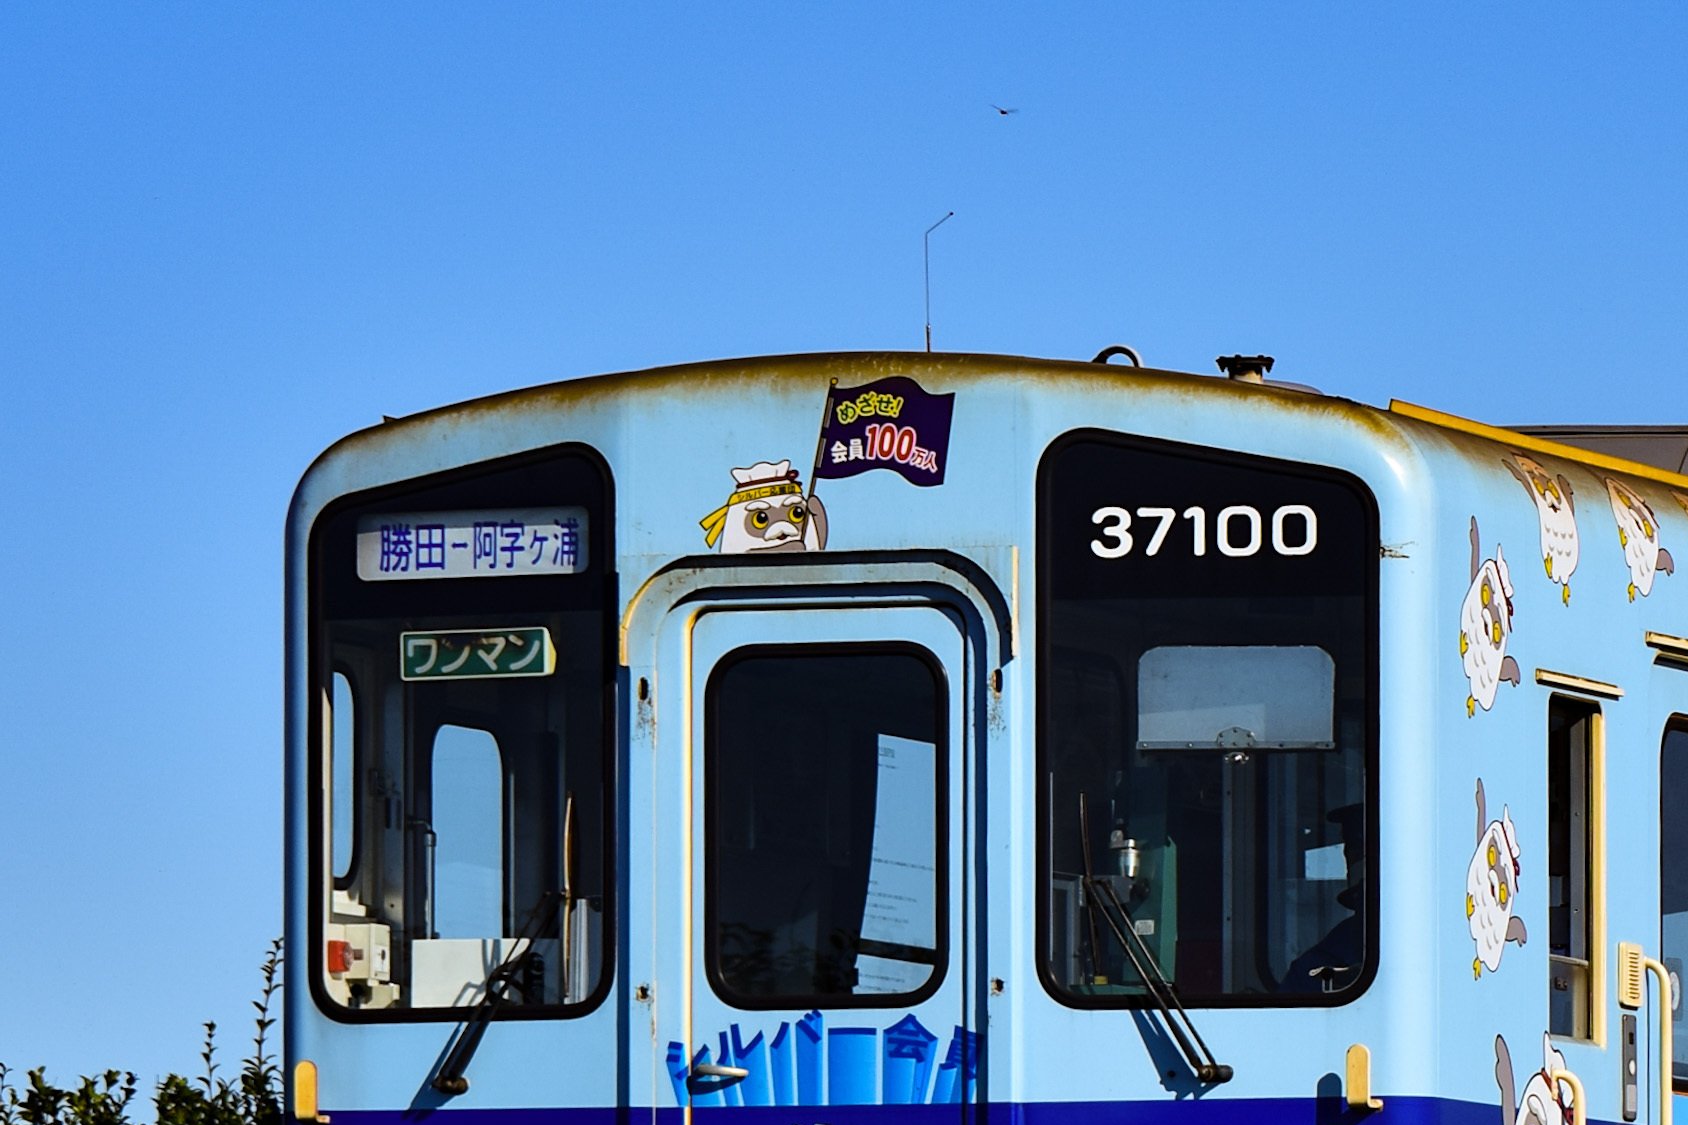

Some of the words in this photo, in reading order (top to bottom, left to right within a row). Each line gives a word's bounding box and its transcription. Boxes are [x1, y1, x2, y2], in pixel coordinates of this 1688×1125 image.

[836, 390, 904, 424] めざせ!
[830, 422, 938, 473] 会員100万人
[1090, 504, 1318, 558] 37100
[408, 634, 541, 674] ワンマン
